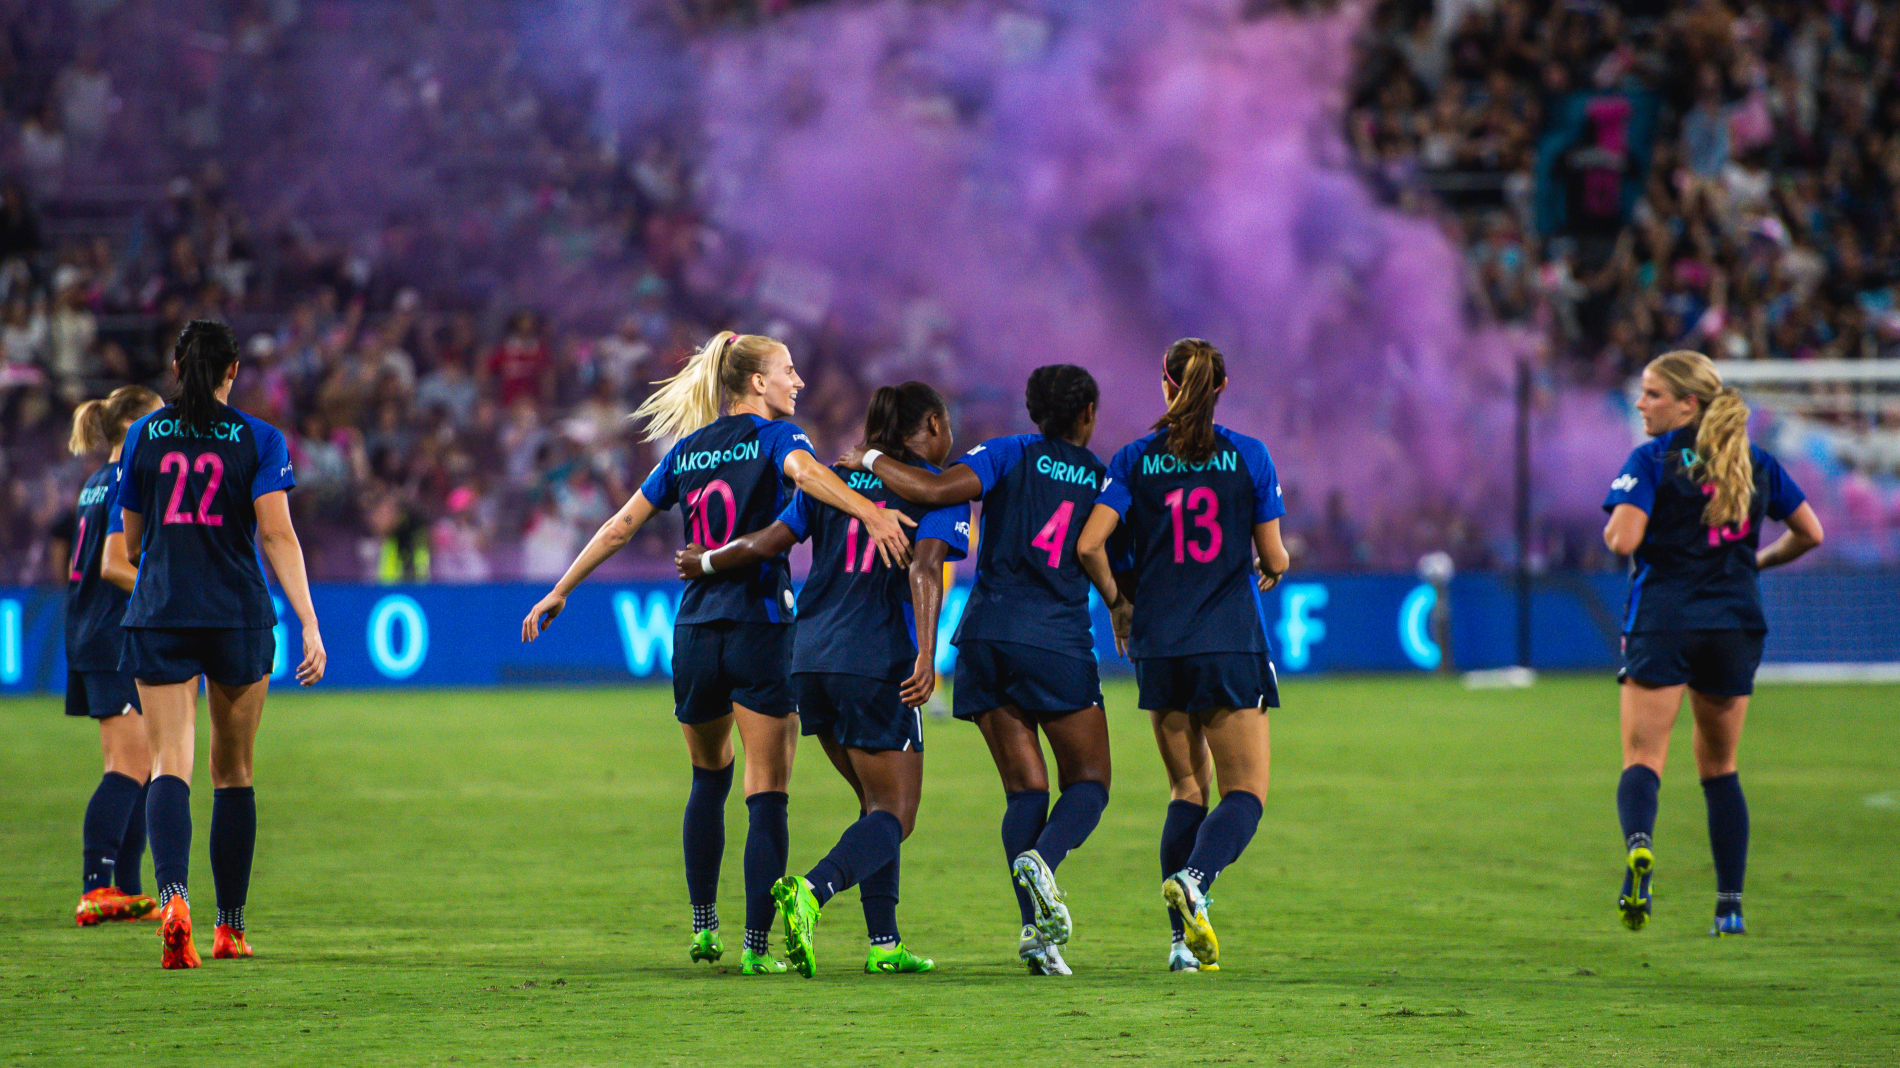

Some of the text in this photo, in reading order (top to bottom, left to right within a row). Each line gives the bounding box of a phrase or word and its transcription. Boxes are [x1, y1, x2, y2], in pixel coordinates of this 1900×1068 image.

[160, 451, 224, 526] 22
[847, 471, 883, 489] SHA
[1036, 454, 1097, 489] GIRMA
[686, 479, 737, 550] 10
[1031, 500, 1075, 569] 4
[1164, 486, 1223, 563] 13
